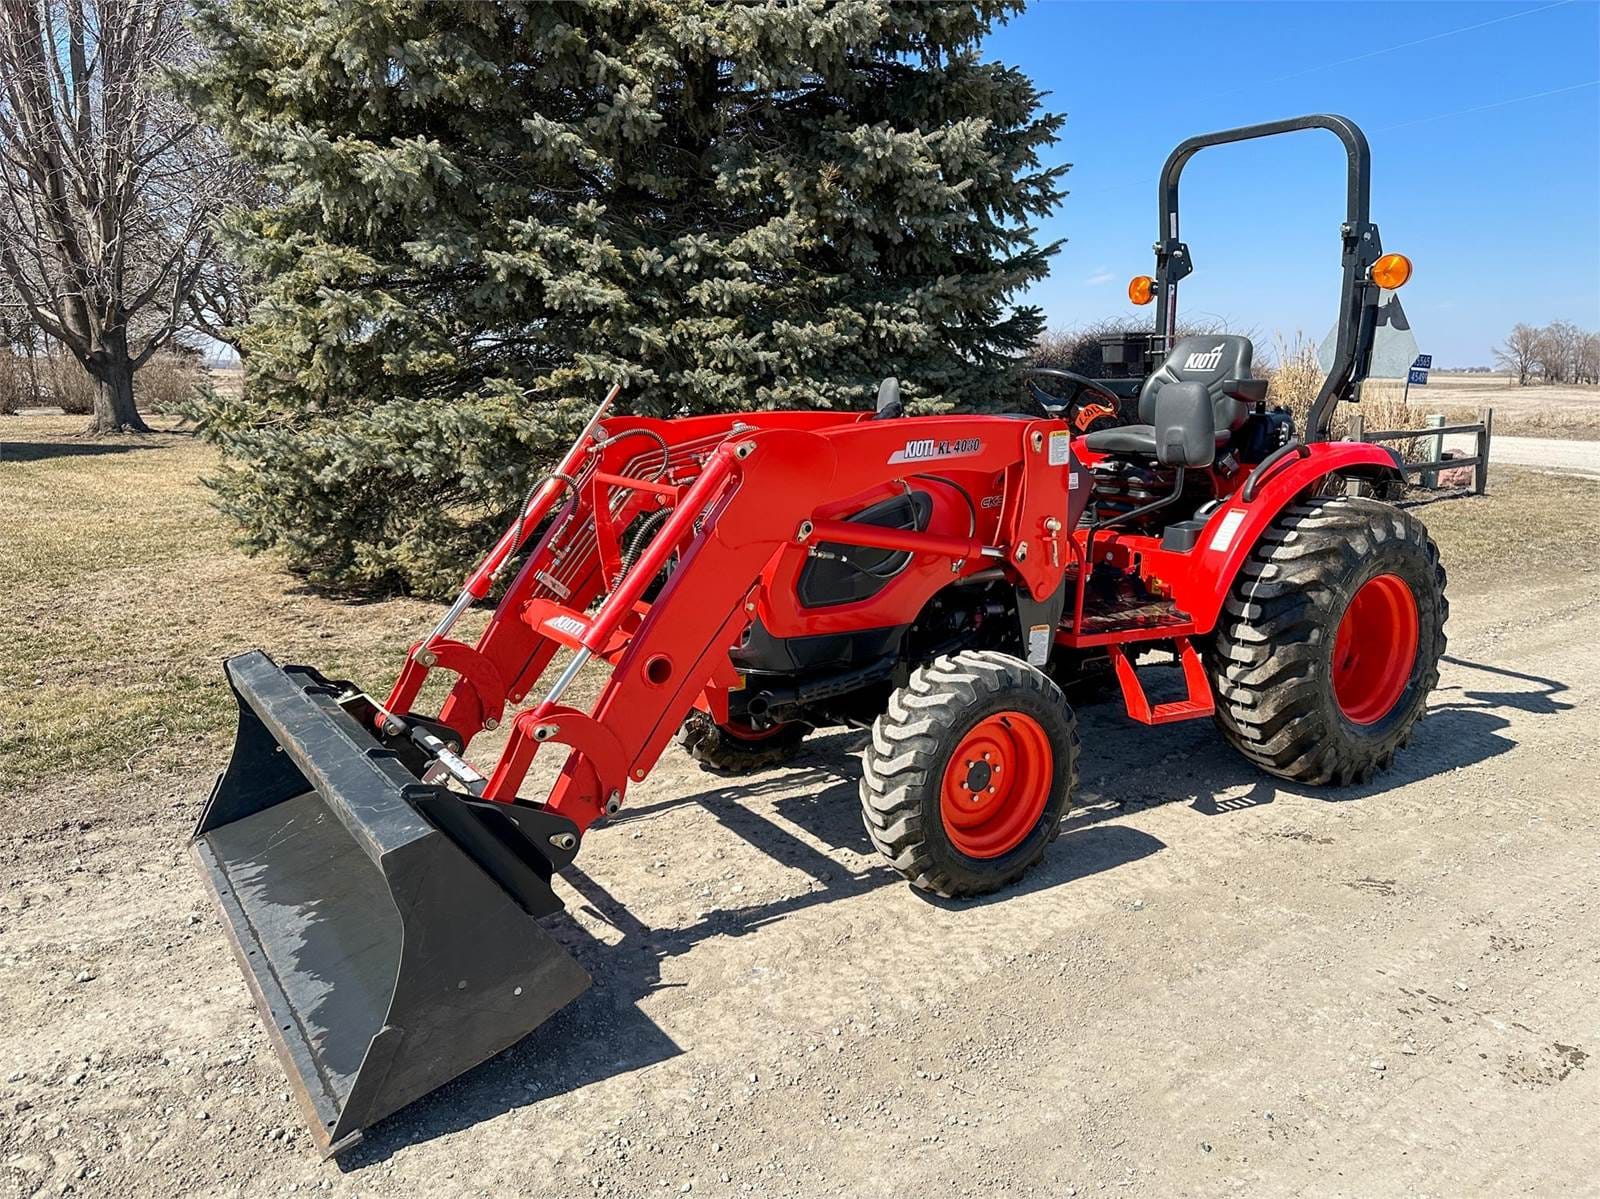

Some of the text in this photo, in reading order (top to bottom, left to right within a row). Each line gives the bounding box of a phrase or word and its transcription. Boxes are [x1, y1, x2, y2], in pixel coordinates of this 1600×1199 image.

[1184, 345, 1225, 369] KIOTI
[904, 439, 934, 458] KIOTI
[938, 441, 951, 455] KL
[552, 616, 586, 635] KIOTI
